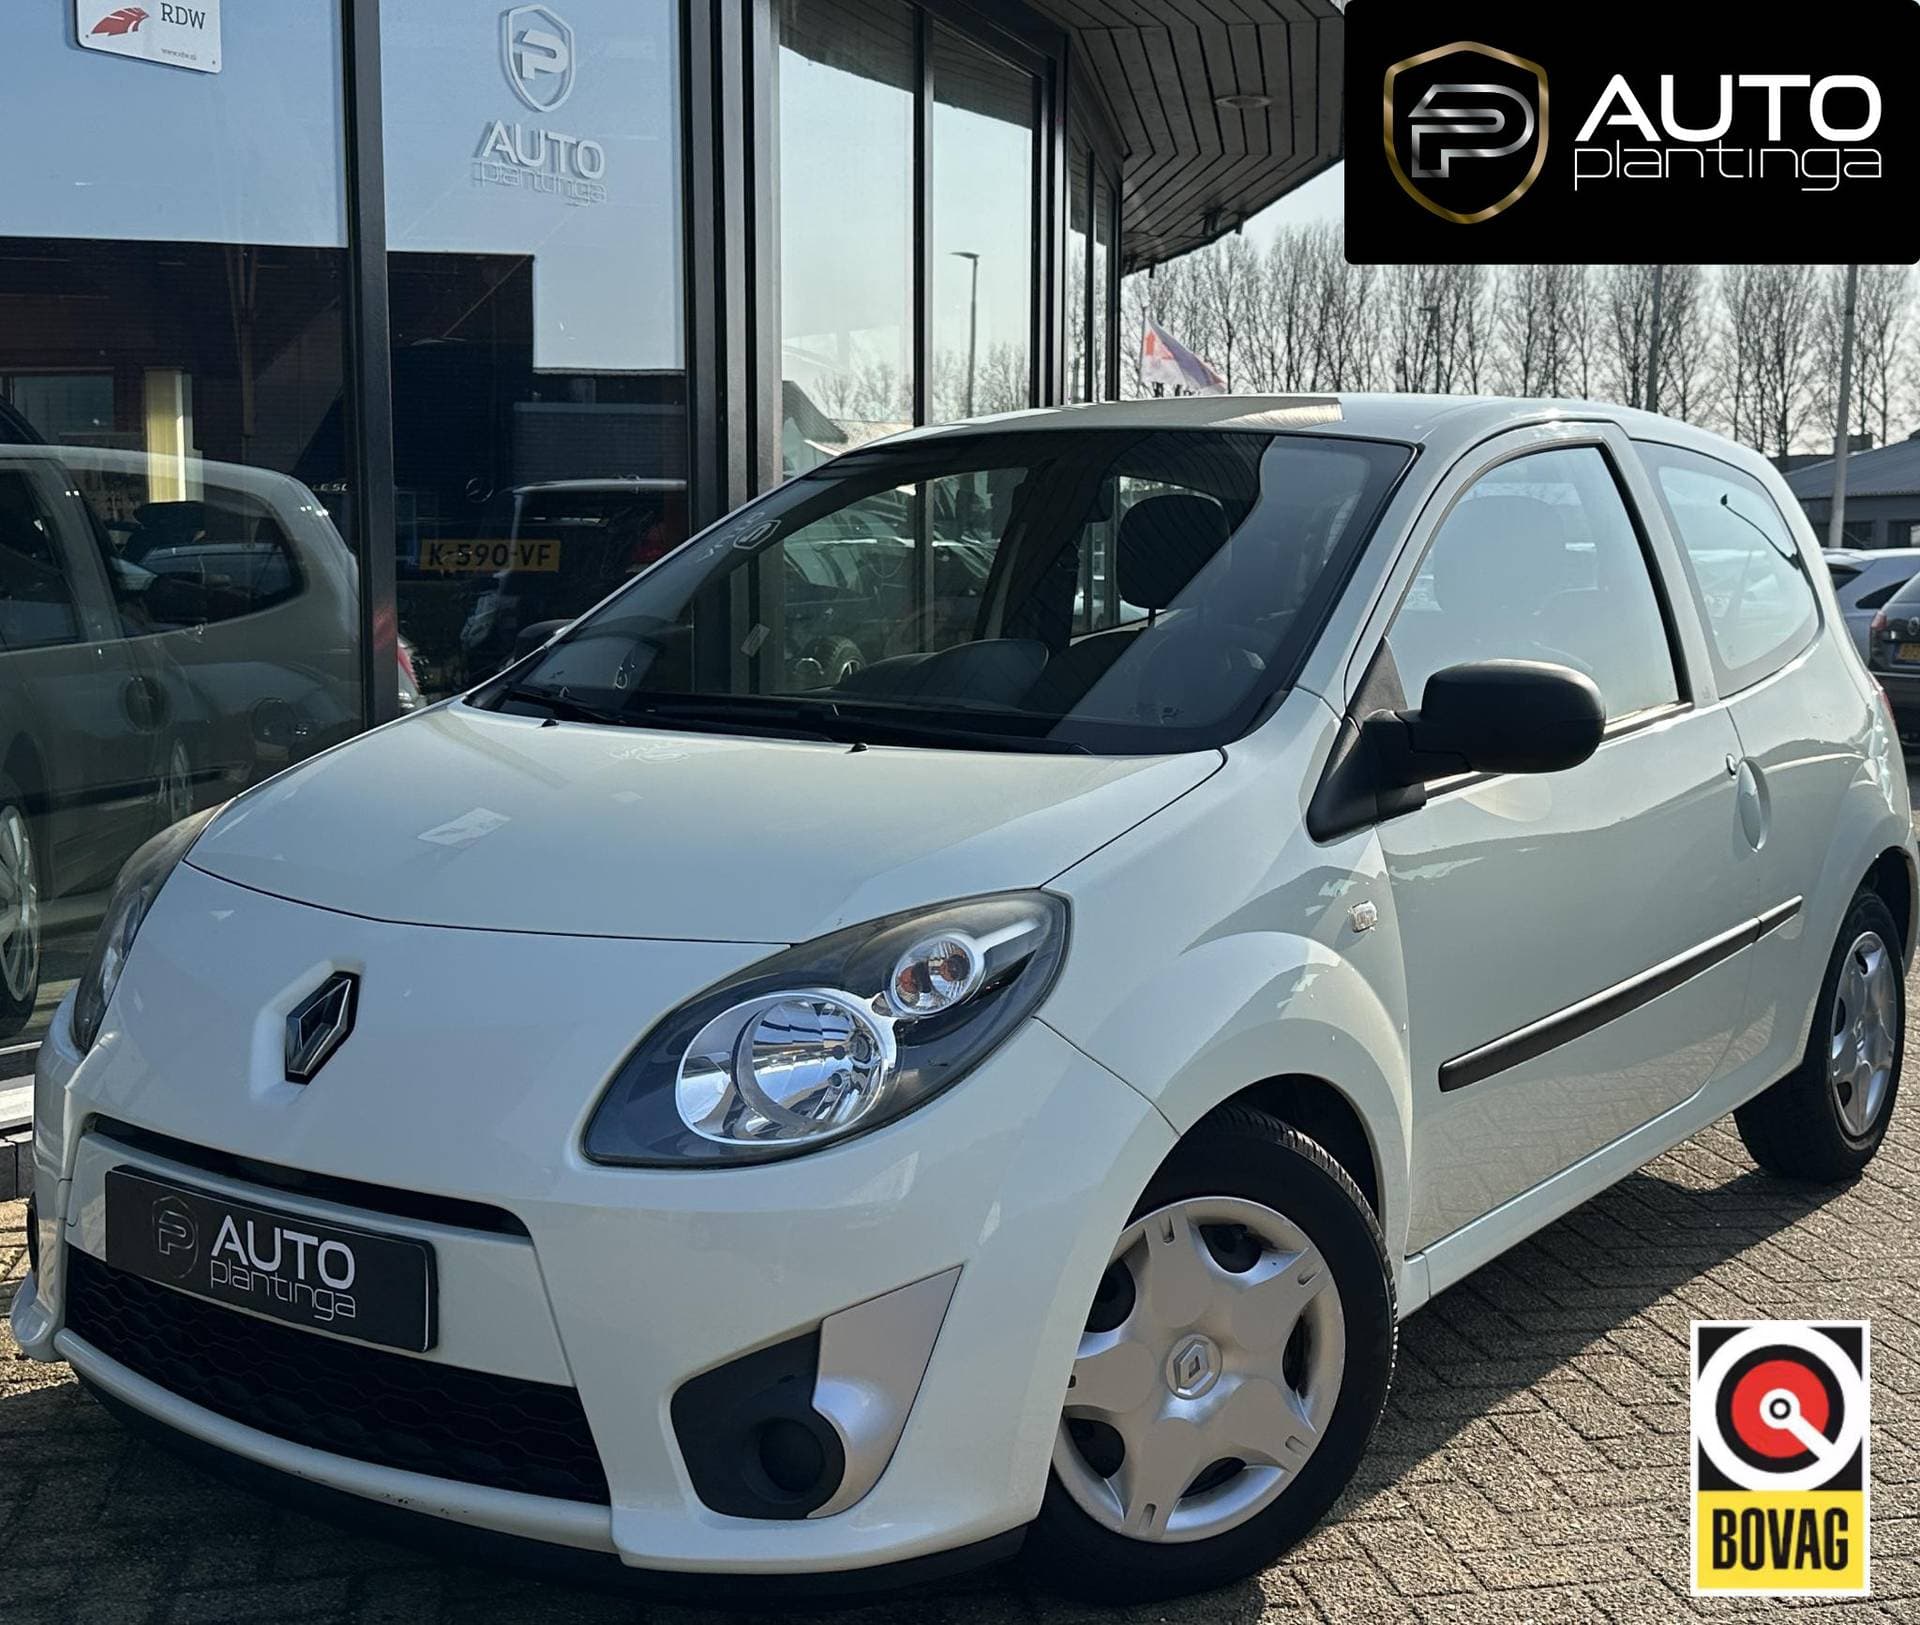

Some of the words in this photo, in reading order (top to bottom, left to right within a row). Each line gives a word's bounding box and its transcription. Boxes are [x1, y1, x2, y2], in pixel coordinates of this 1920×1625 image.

[160, 2, 206, 30] RDW
[481, 119, 606, 180] AUTO
[428, 543, 552, 567] K-590-VF
[210, 1214, 356, 1290] AUTO
[210, 1259, 356, 1321] plantinga
